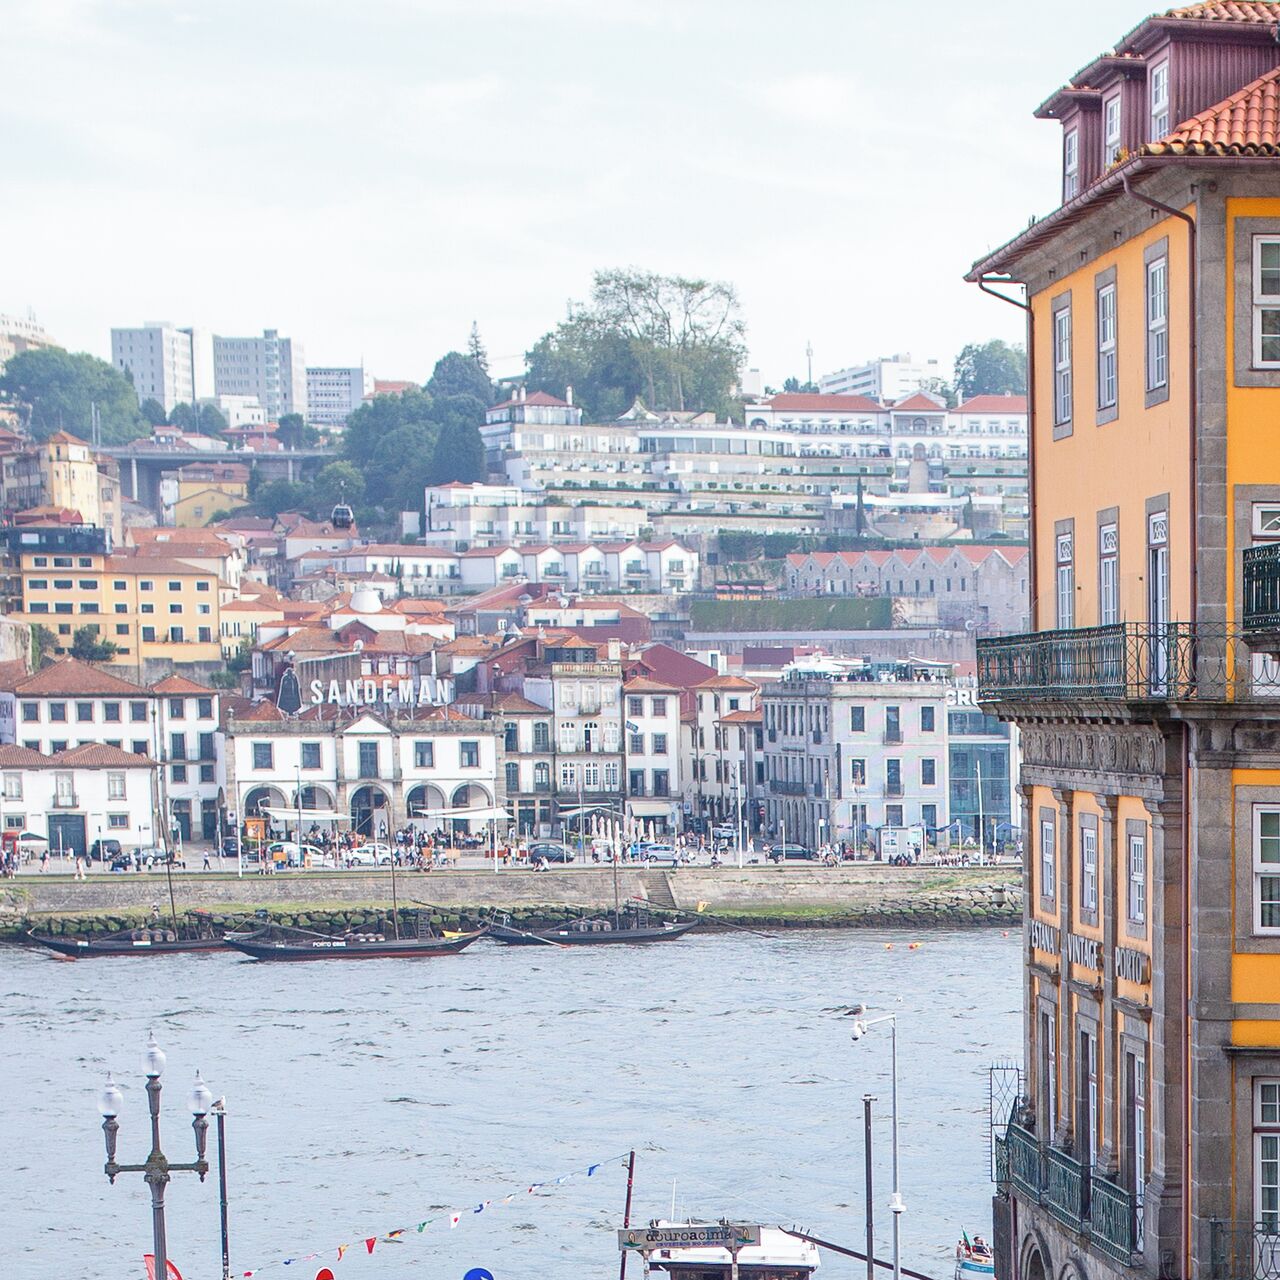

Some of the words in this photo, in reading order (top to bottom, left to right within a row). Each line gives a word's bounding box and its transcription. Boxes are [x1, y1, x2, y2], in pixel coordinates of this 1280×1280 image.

[310, 679, 449, 704] SANDEMAN
[1031, 920, 1055, 955] ESTANA
[1067, 933, 1098, 971] VINTAGE
[1115, 946, 1143, 985] PORTO
[646, 1229, 733, 1242] douroacima
